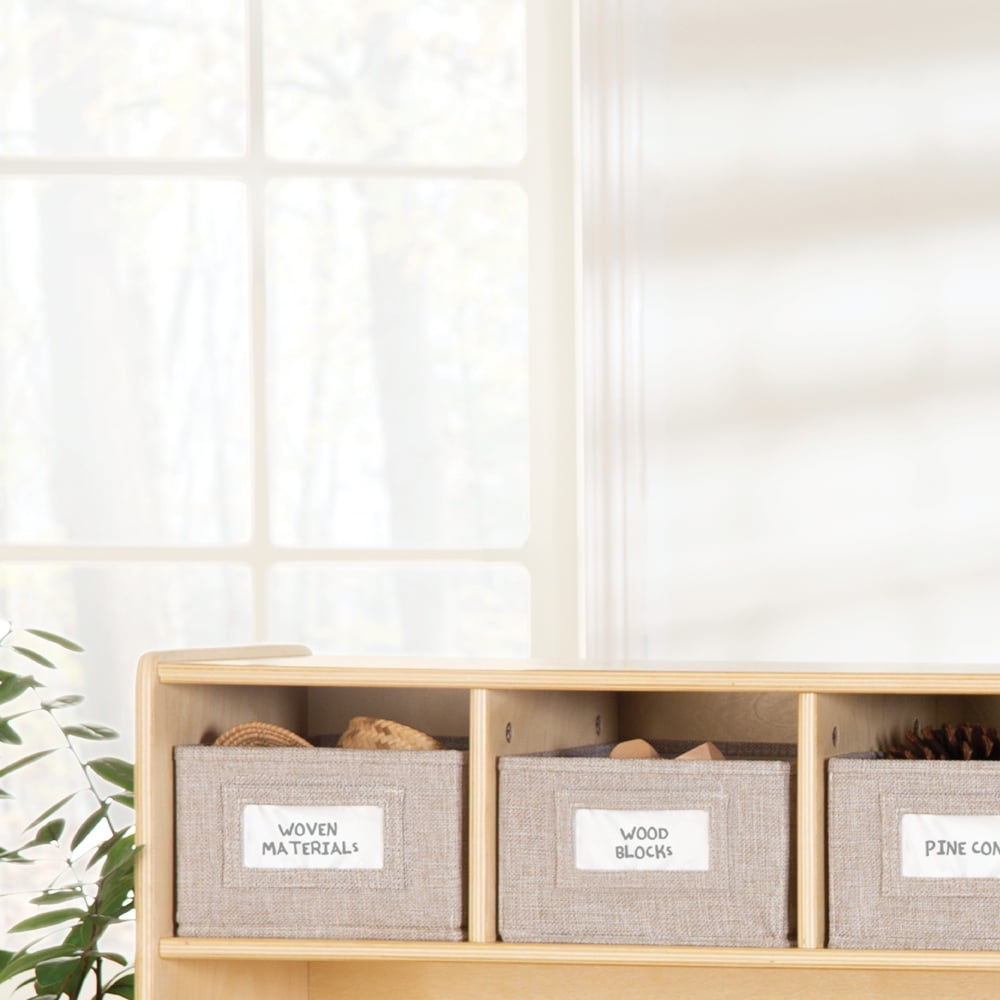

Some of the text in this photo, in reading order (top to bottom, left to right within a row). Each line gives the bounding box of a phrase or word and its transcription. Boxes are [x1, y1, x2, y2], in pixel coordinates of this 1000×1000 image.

[278, 822, 337, 836] WOVEN
[620, 826, 669, 840] WOOD
[262, 841, 359, 855] MATERIALS
[615, 845, 673, 859] BLOCKS
[925, 840, 967, 856] PINE
